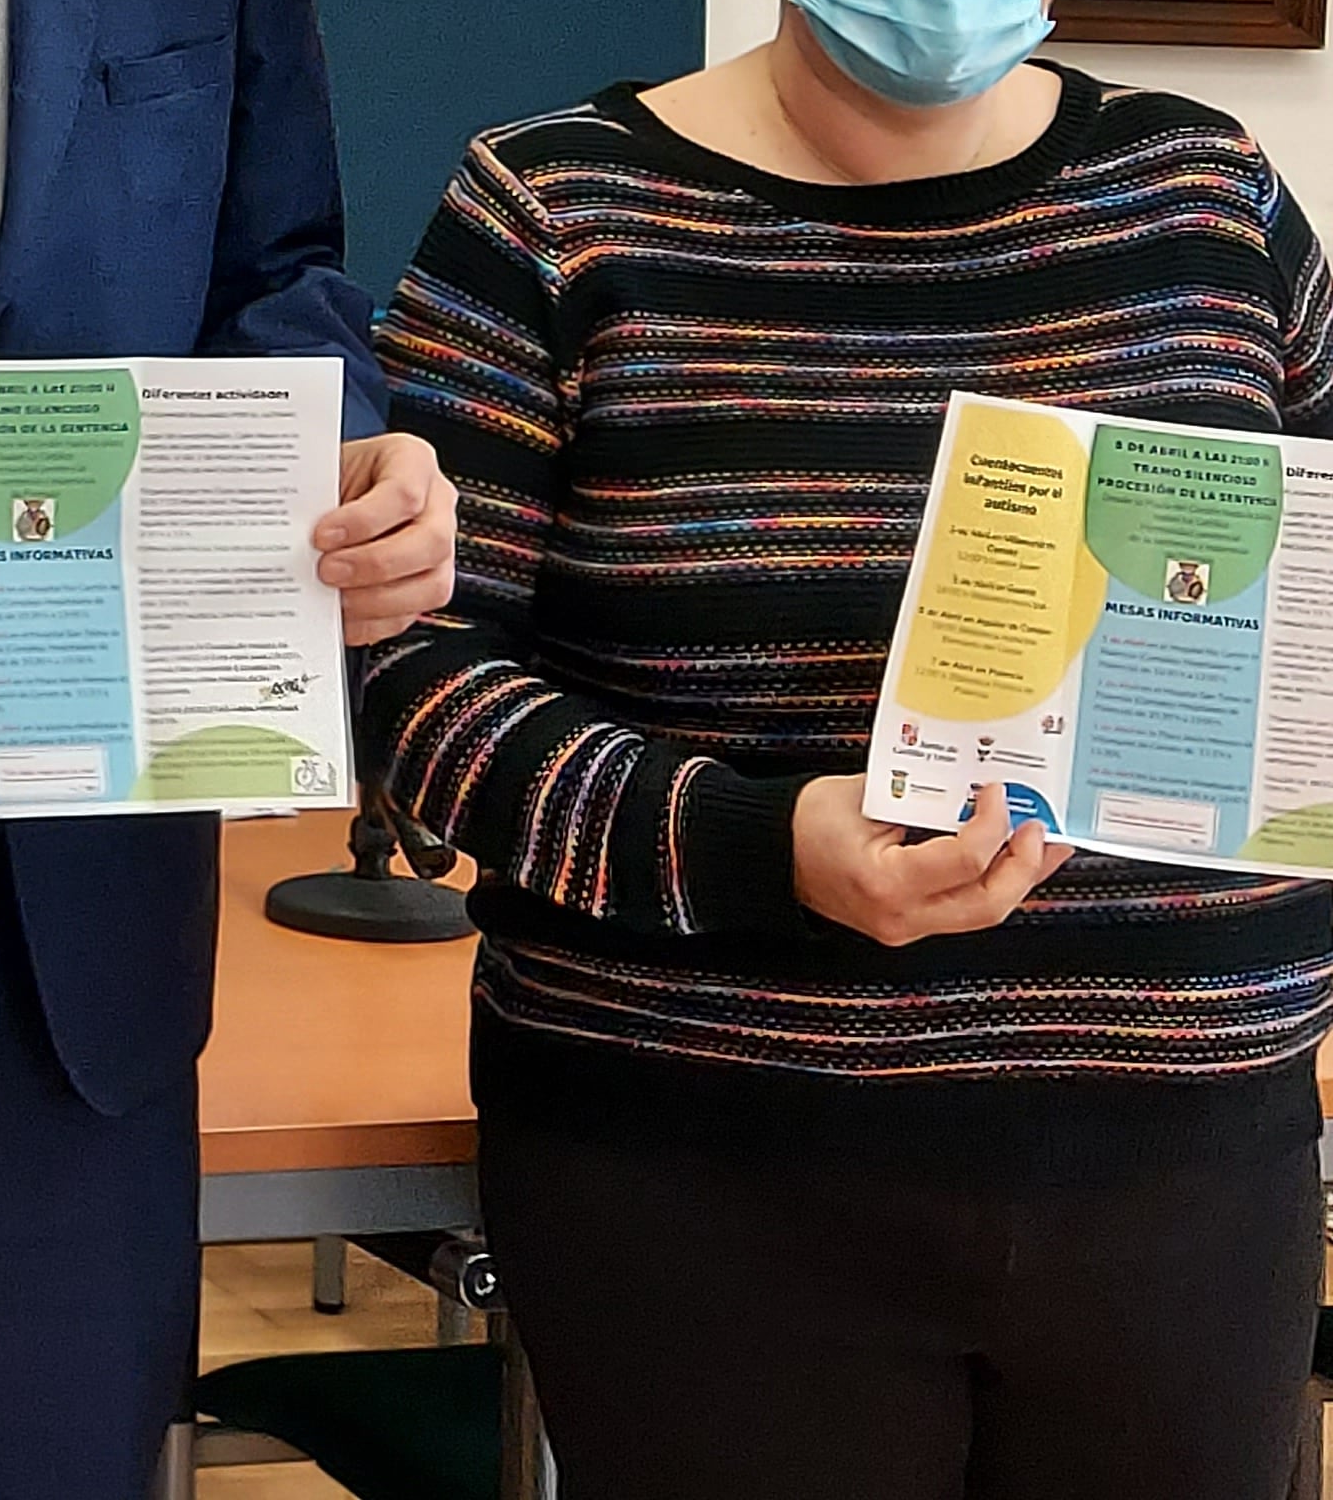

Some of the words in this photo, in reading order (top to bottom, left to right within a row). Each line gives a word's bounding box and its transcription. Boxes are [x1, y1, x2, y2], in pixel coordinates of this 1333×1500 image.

[1128, 442, 1145, 453] DE
[1149, 443, 1188, 459] ABRIL
[1192, 450, 1201, 460] A
[1205, 452, 1228, 463] LAS
[970, 453, 1063, 480] Cuentacuentos
[1133, 462, 1181, 478] TRAMO
[1184, 470, 1257, 486] SILENCIOSO
[1028, 485, 1050, 498] por
[1051, 487, 1062, 499] el
[1097, 477, 1176, 496] PROCESIÓN
[1179, 487, 1196, 499] DE
[1200, 489, 1216, 500] LA
[984, 497, 1037, 515] autismo
[10, 548, 113, 562] INFORMATIVAS
[1105, 601, 1155, 618] MESAS
[1157, 608, 1260, 631] INFORMATIVAS
